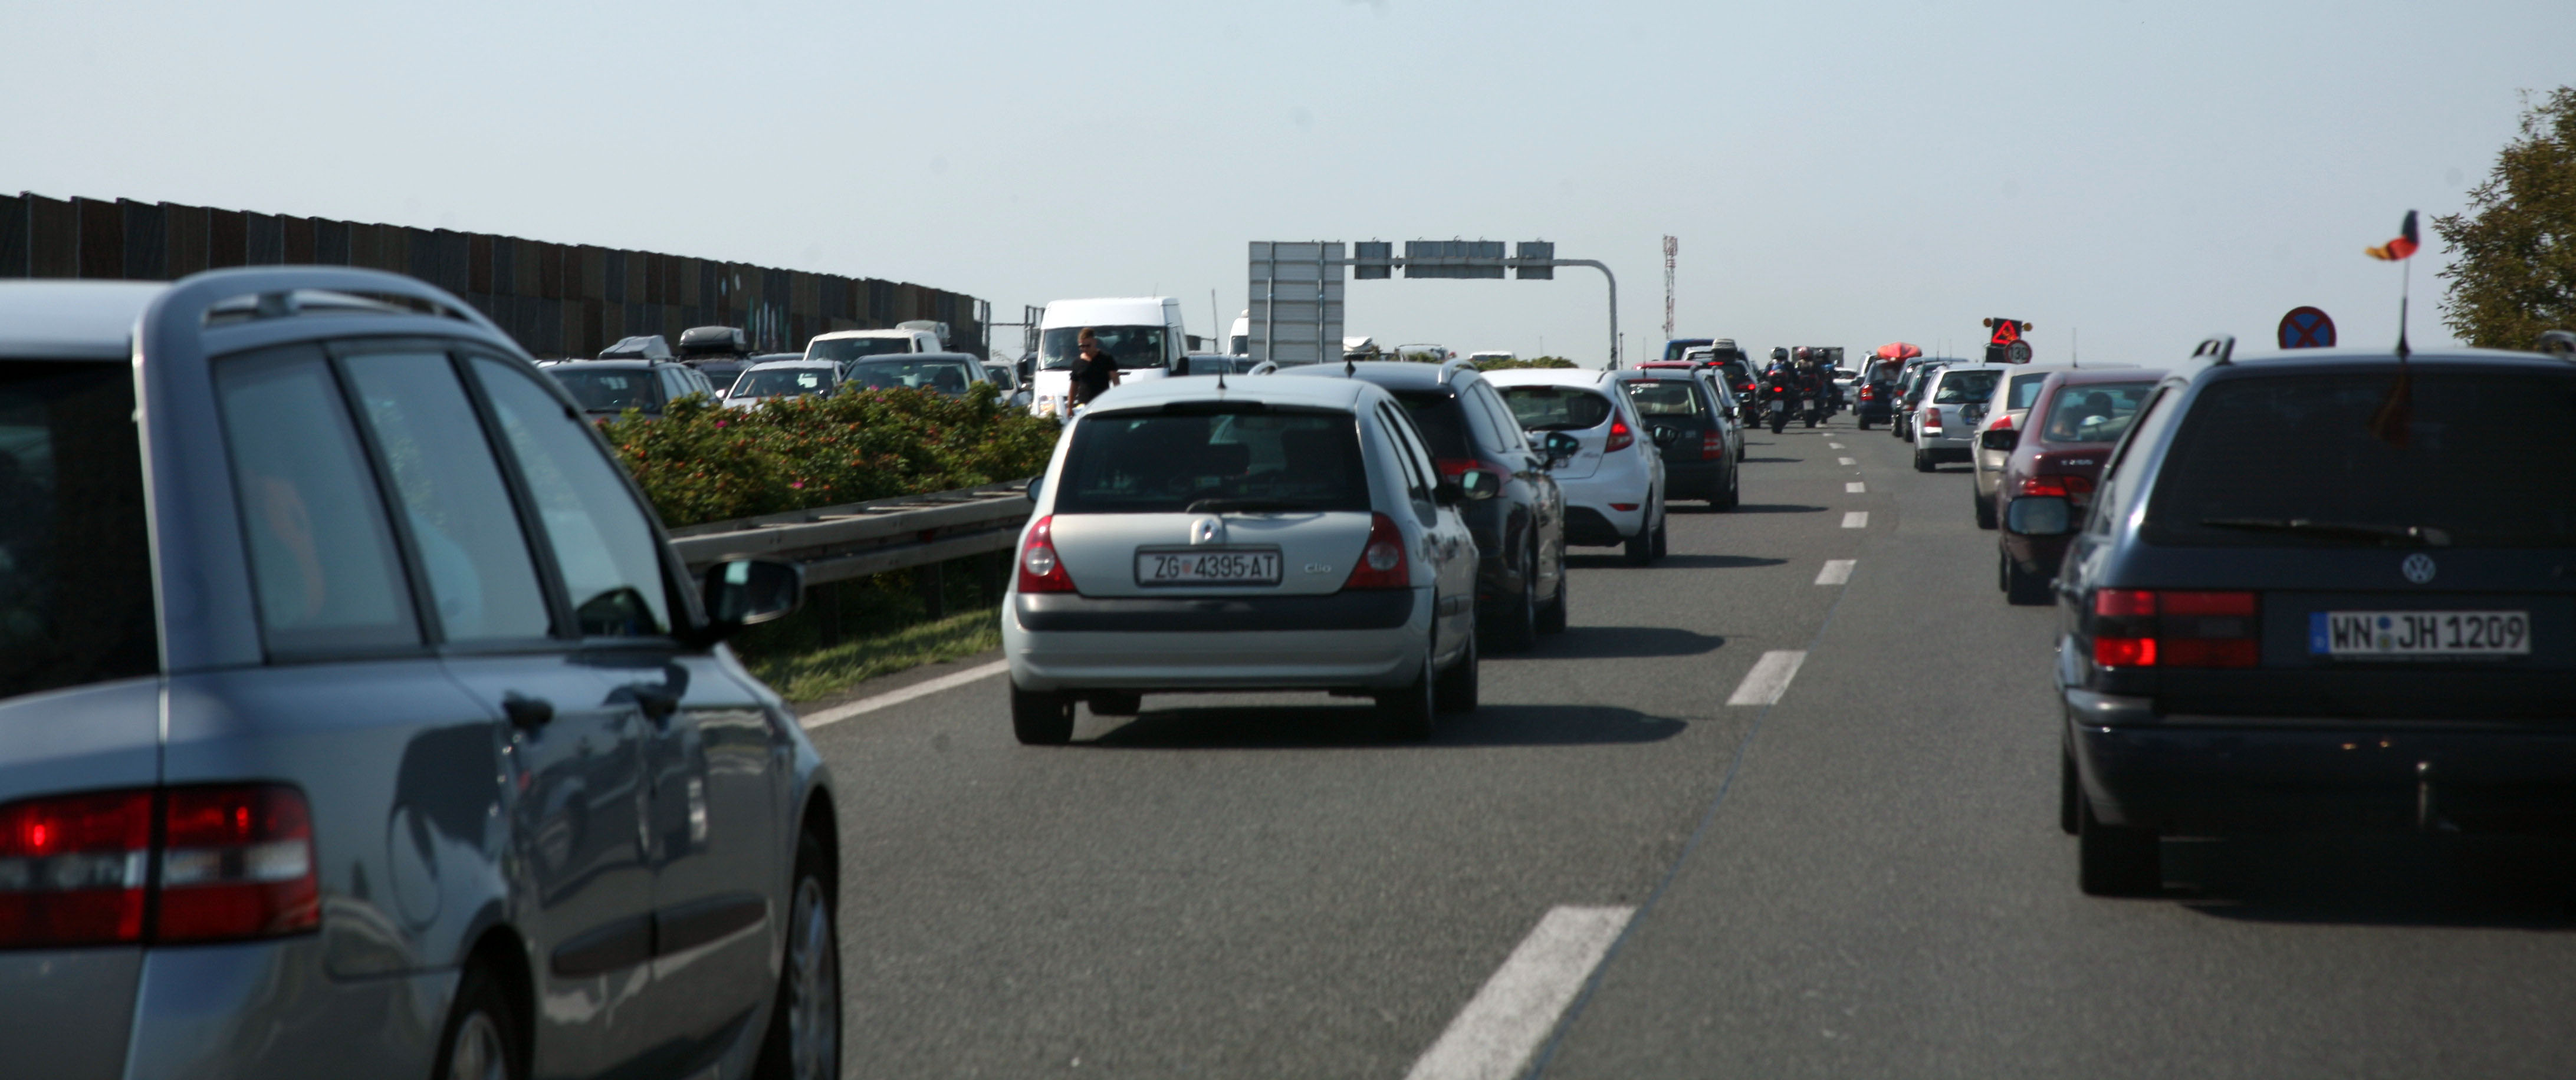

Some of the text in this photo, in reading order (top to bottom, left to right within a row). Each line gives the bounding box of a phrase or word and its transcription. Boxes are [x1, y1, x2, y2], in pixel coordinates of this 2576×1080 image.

[2010, 346, 2028, 360] 130
[1155, 556, 1179, 578] ZG
[2332, 615, 2525, 648] WN JH 1209
